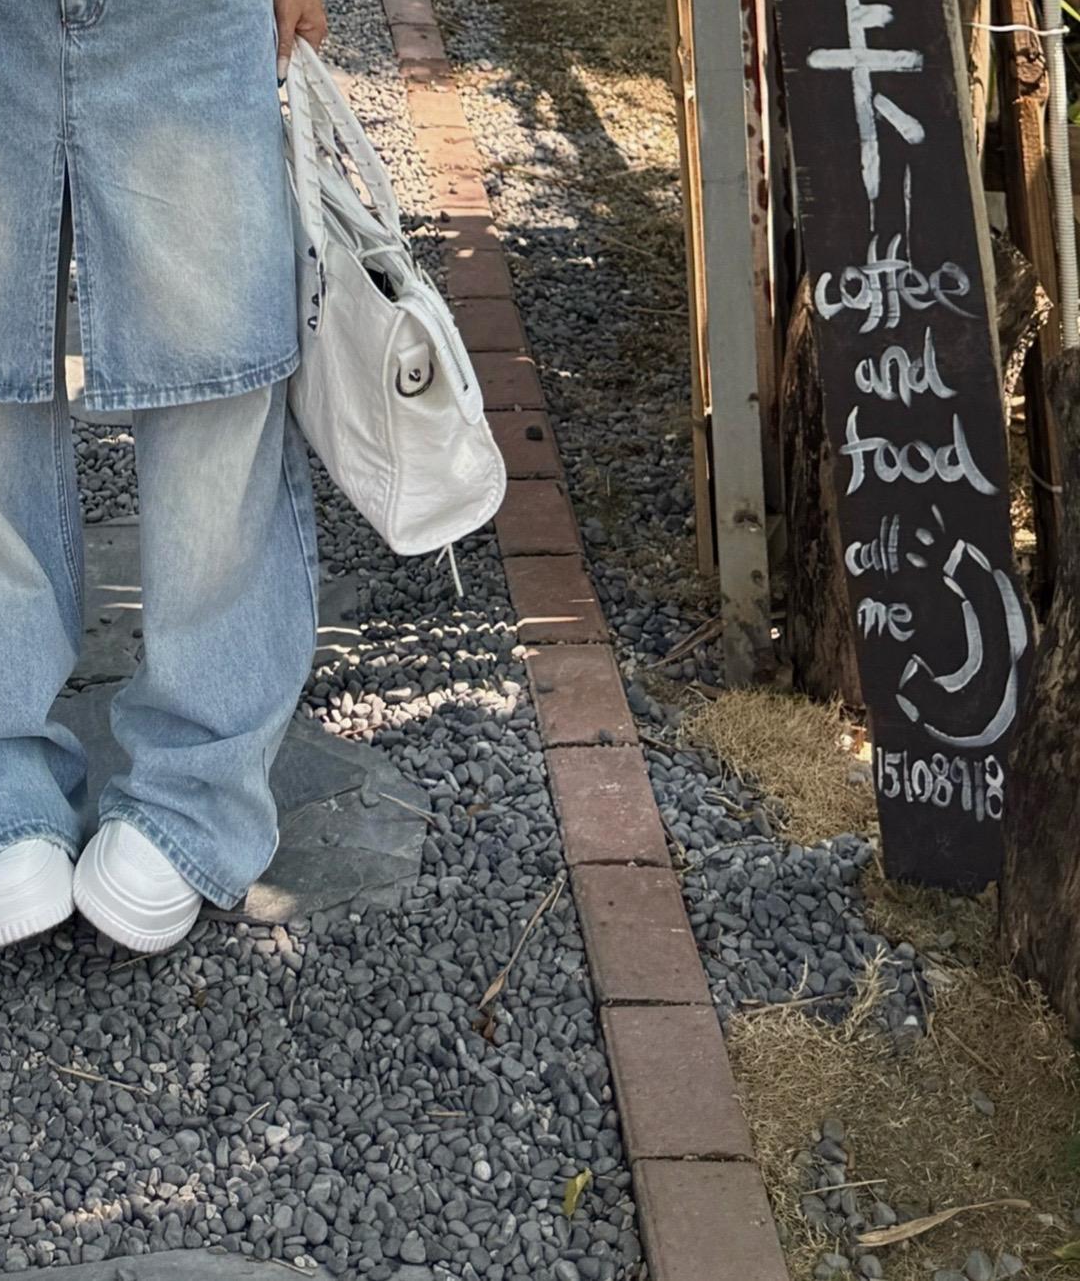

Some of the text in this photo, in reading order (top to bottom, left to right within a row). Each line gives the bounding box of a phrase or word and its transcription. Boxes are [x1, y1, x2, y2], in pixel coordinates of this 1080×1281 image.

[815, 233, 981, 333] coffee
[855, 326, 957, 408] and
[839, 406, 1000, 496] food
[845, 514, 900, 579] call
[857, 597, 916, 642] me
